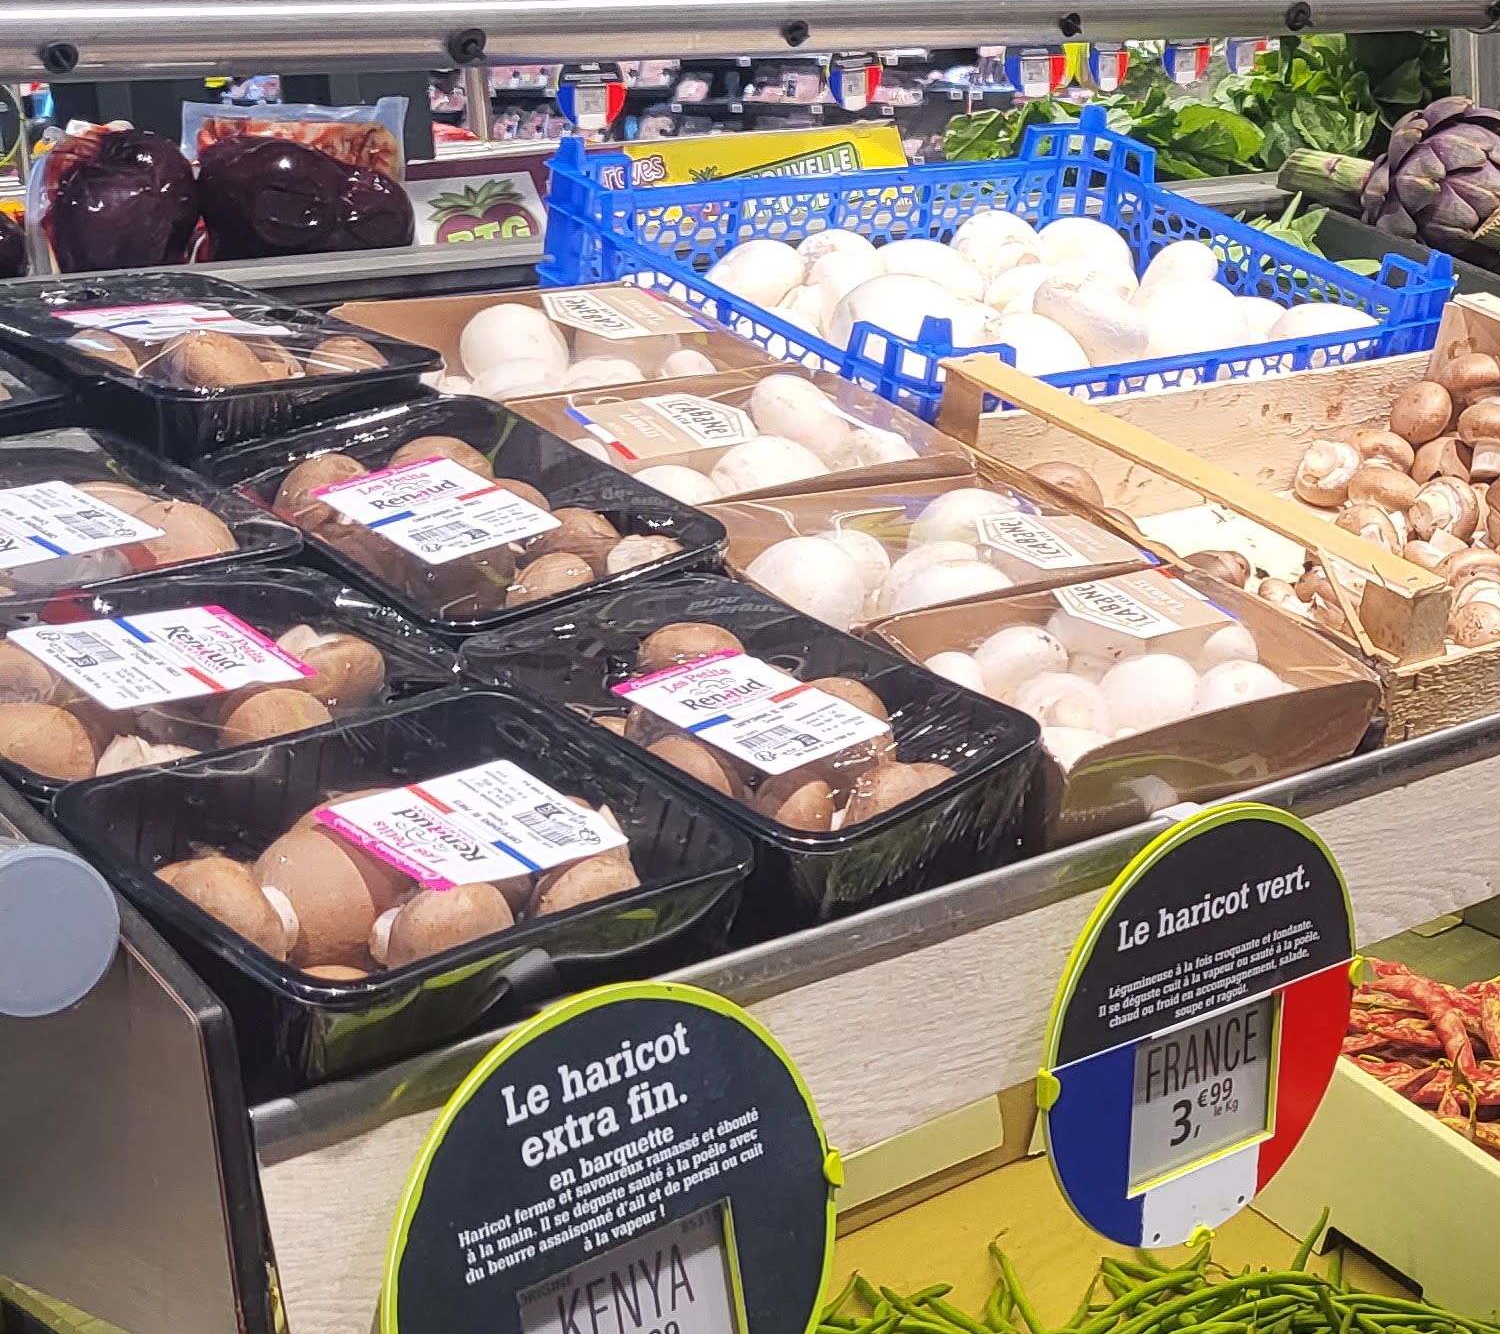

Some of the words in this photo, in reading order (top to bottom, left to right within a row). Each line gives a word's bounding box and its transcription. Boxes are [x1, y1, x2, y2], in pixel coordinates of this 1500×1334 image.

[369, 479, 458, 510] Renaud
[162, 623, 246, 671] Renaud
[680, 677, 768, 712] Renaud
[391, 807, 489, 863] Renaud
[1117, 920, 1150, 952] Le
[1157, 882, 1250, 938] haricot
[1256, 864, 1311, 904] vert.
[1098, 1004, 1107, 1018] Il
[1108, 1002, 1120, 1014] se
[1122, 987, 1161, 1009] déguste
[1163, 978, 1181, 994] cuit
[1183, 975, 1189, 987] à
[1191, 972, 1201, 984] la
[1202, 960, 1235, 980] vapeur
[1237, 957, 1248, 968] ou
[1250, 945, 1274, 963] sauté
[1276, 942, 1282, 954] à
[1283, 939, 1293, 951] la
[1108, 968, 1174, 1000] Légumineuse
[1175, 963, 1182, 976] à
[1184, 961, 1193, 973] la
[1195, 954, 1213, 970] fois
[1214, 938, 1260, 963] croquante
[1262, 932, 1271, 945] et
[1273, 920, 1314, 942] fondante.
[1109, 1007, 1140, 1028] chaud
[1142, 1004, 1154, 1017] ou
[1156, 992, 1179, 1012] froid
[1181, 990, 1194, 1002] en
[1174, 1000, 1204, 1019] soupe
[1205, 995, 1215, 1007] et
[501, 1084, 550, 1126] Le
[557, 1022, 691, 1104] haricot
[1146, 1010, 1258, 1104] FRANCE
[521, 1106, 620, 1167] extra
[627, 1081, 688, 1124] fin.
[1213, 1105, 1223, 1117] le
[1226, 1098, 1239, 1113] Kg
[458, 1213, 512, 1249] Haricot
[514, 1197, 556, 1225] ferme
[558, 1188, 573, 1205] et
[575, 1159, 644, 1199] savoureux
[646, 1132, 700, 1168] ramassé
[701, 1127, 714, 1143] et
[717, 1107, 759, 1136] ébouté
[549, 1168, 576, 1192] en
[579, 1126, 675, 1180] barquette
[465, 1267, 485, 1285] du
[487, 1244, 536, 1276] beurre
[539, 1208, 614, 1253] assaisonné
[616, 1193, 646, 1218] d'ail
[648, 1188, 662, 1204] et
[664, 1181, 681, 1197] de
[683, 1161, 720, 1192] persil
[721, 1157, 738, 1171] ou
[740, 1142, 764, 1163] cuit
[466, 1248, 476, 1264] à
[479, 1243, 494, 1259] la
[497, 1226, 538, 1252] main.
[540, 1216, 550, 1233] Il
[554, 1210, 570, 1227] se
[572, 1186, 626, 1219] déguste
[628, 1167, 664, 1194] sauté
[666, 1162, 675, 1178] à
[676, 1158, 691, 1174] la
[692, 1142, 727, 1169] poêle
[729, 1128, 759, 1150] avec
[583, 1236, 593, 1252] à
[595, 1231, 609, 1247] la
[611, 1208, 657, 1240] vapeur
[659, 1203, 666, 1218] !
